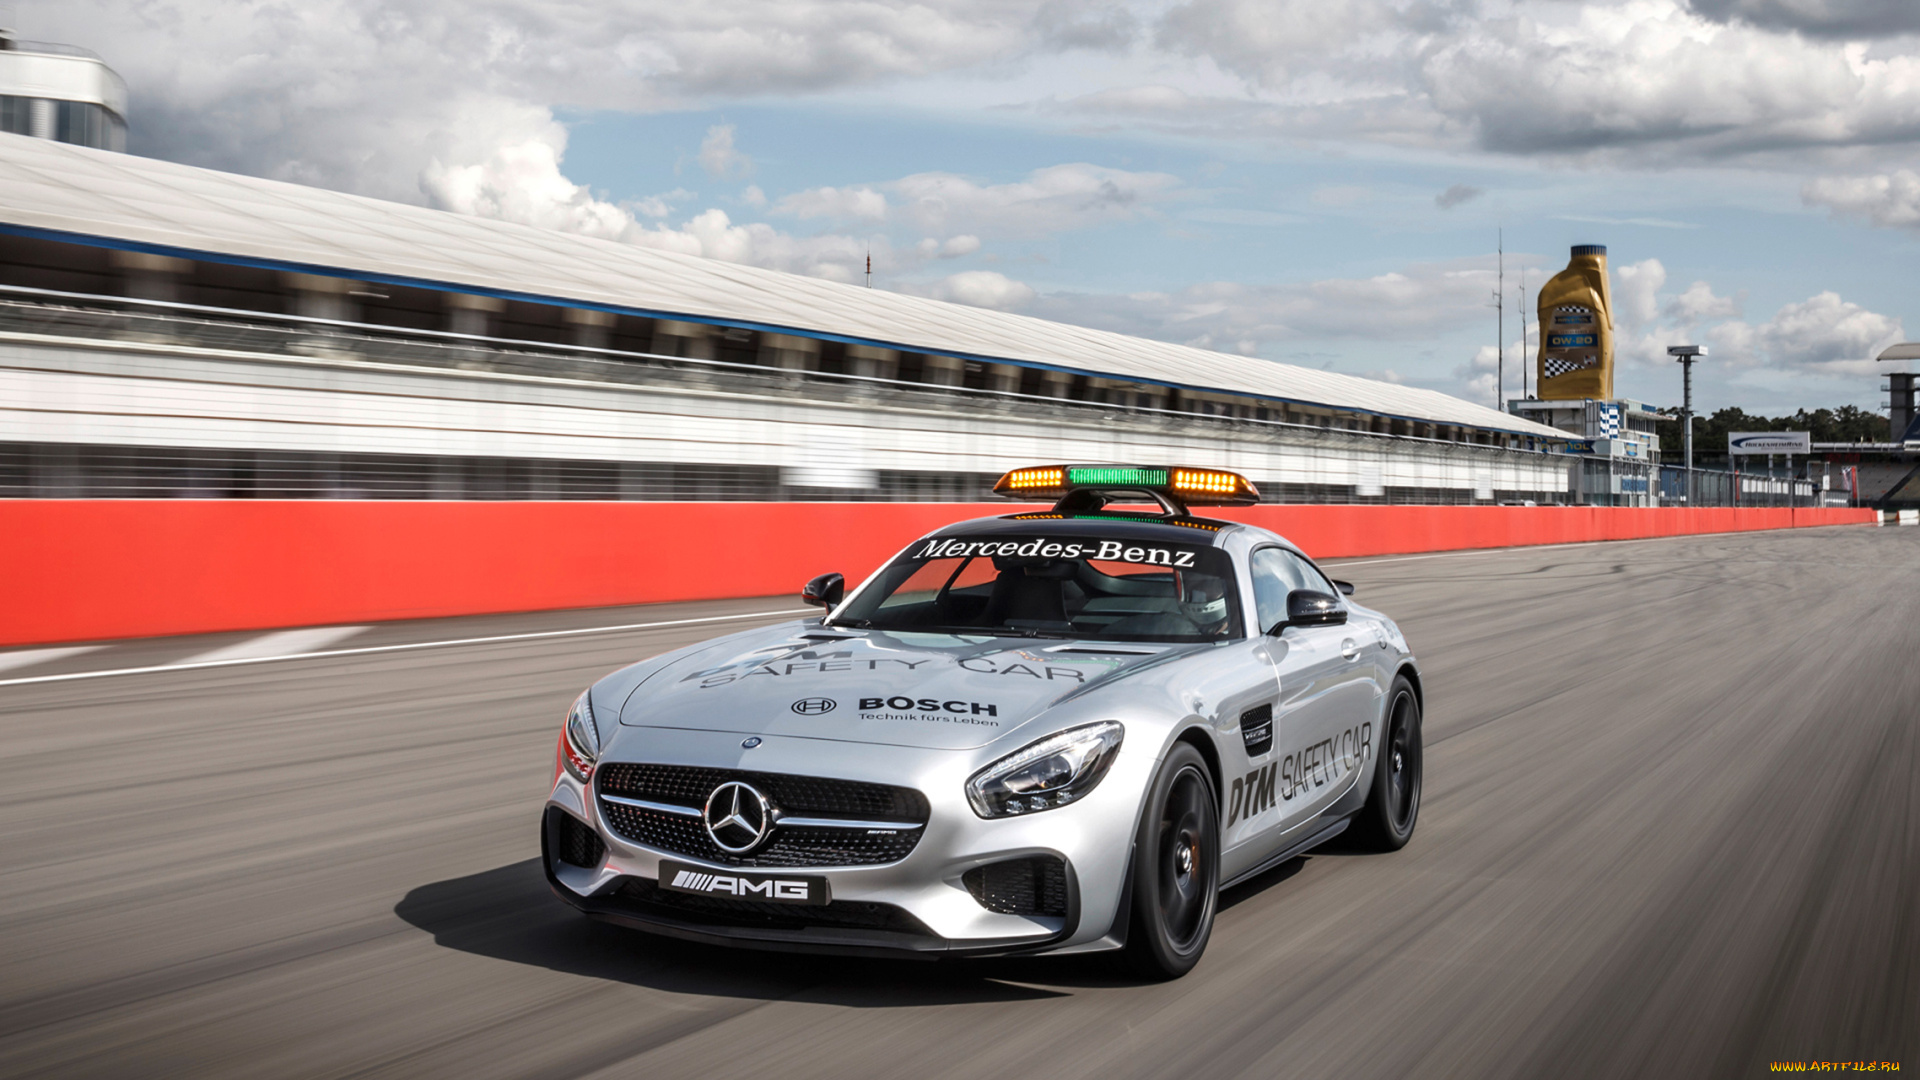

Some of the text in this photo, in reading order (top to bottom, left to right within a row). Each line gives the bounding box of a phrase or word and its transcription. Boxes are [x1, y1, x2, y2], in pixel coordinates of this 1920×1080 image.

[912, 538, 1195, 567] Mercedes-Benz
[699, 658, 1086, 689] SAFETY CAR
[858, 696, 998, 717] BOSCH
[858, 713, 999, 727] Technik fürs Leben
[1226, 721, 1372, 830] DTM SAFETY CAR
[705, 876, 808, 900] AMG
